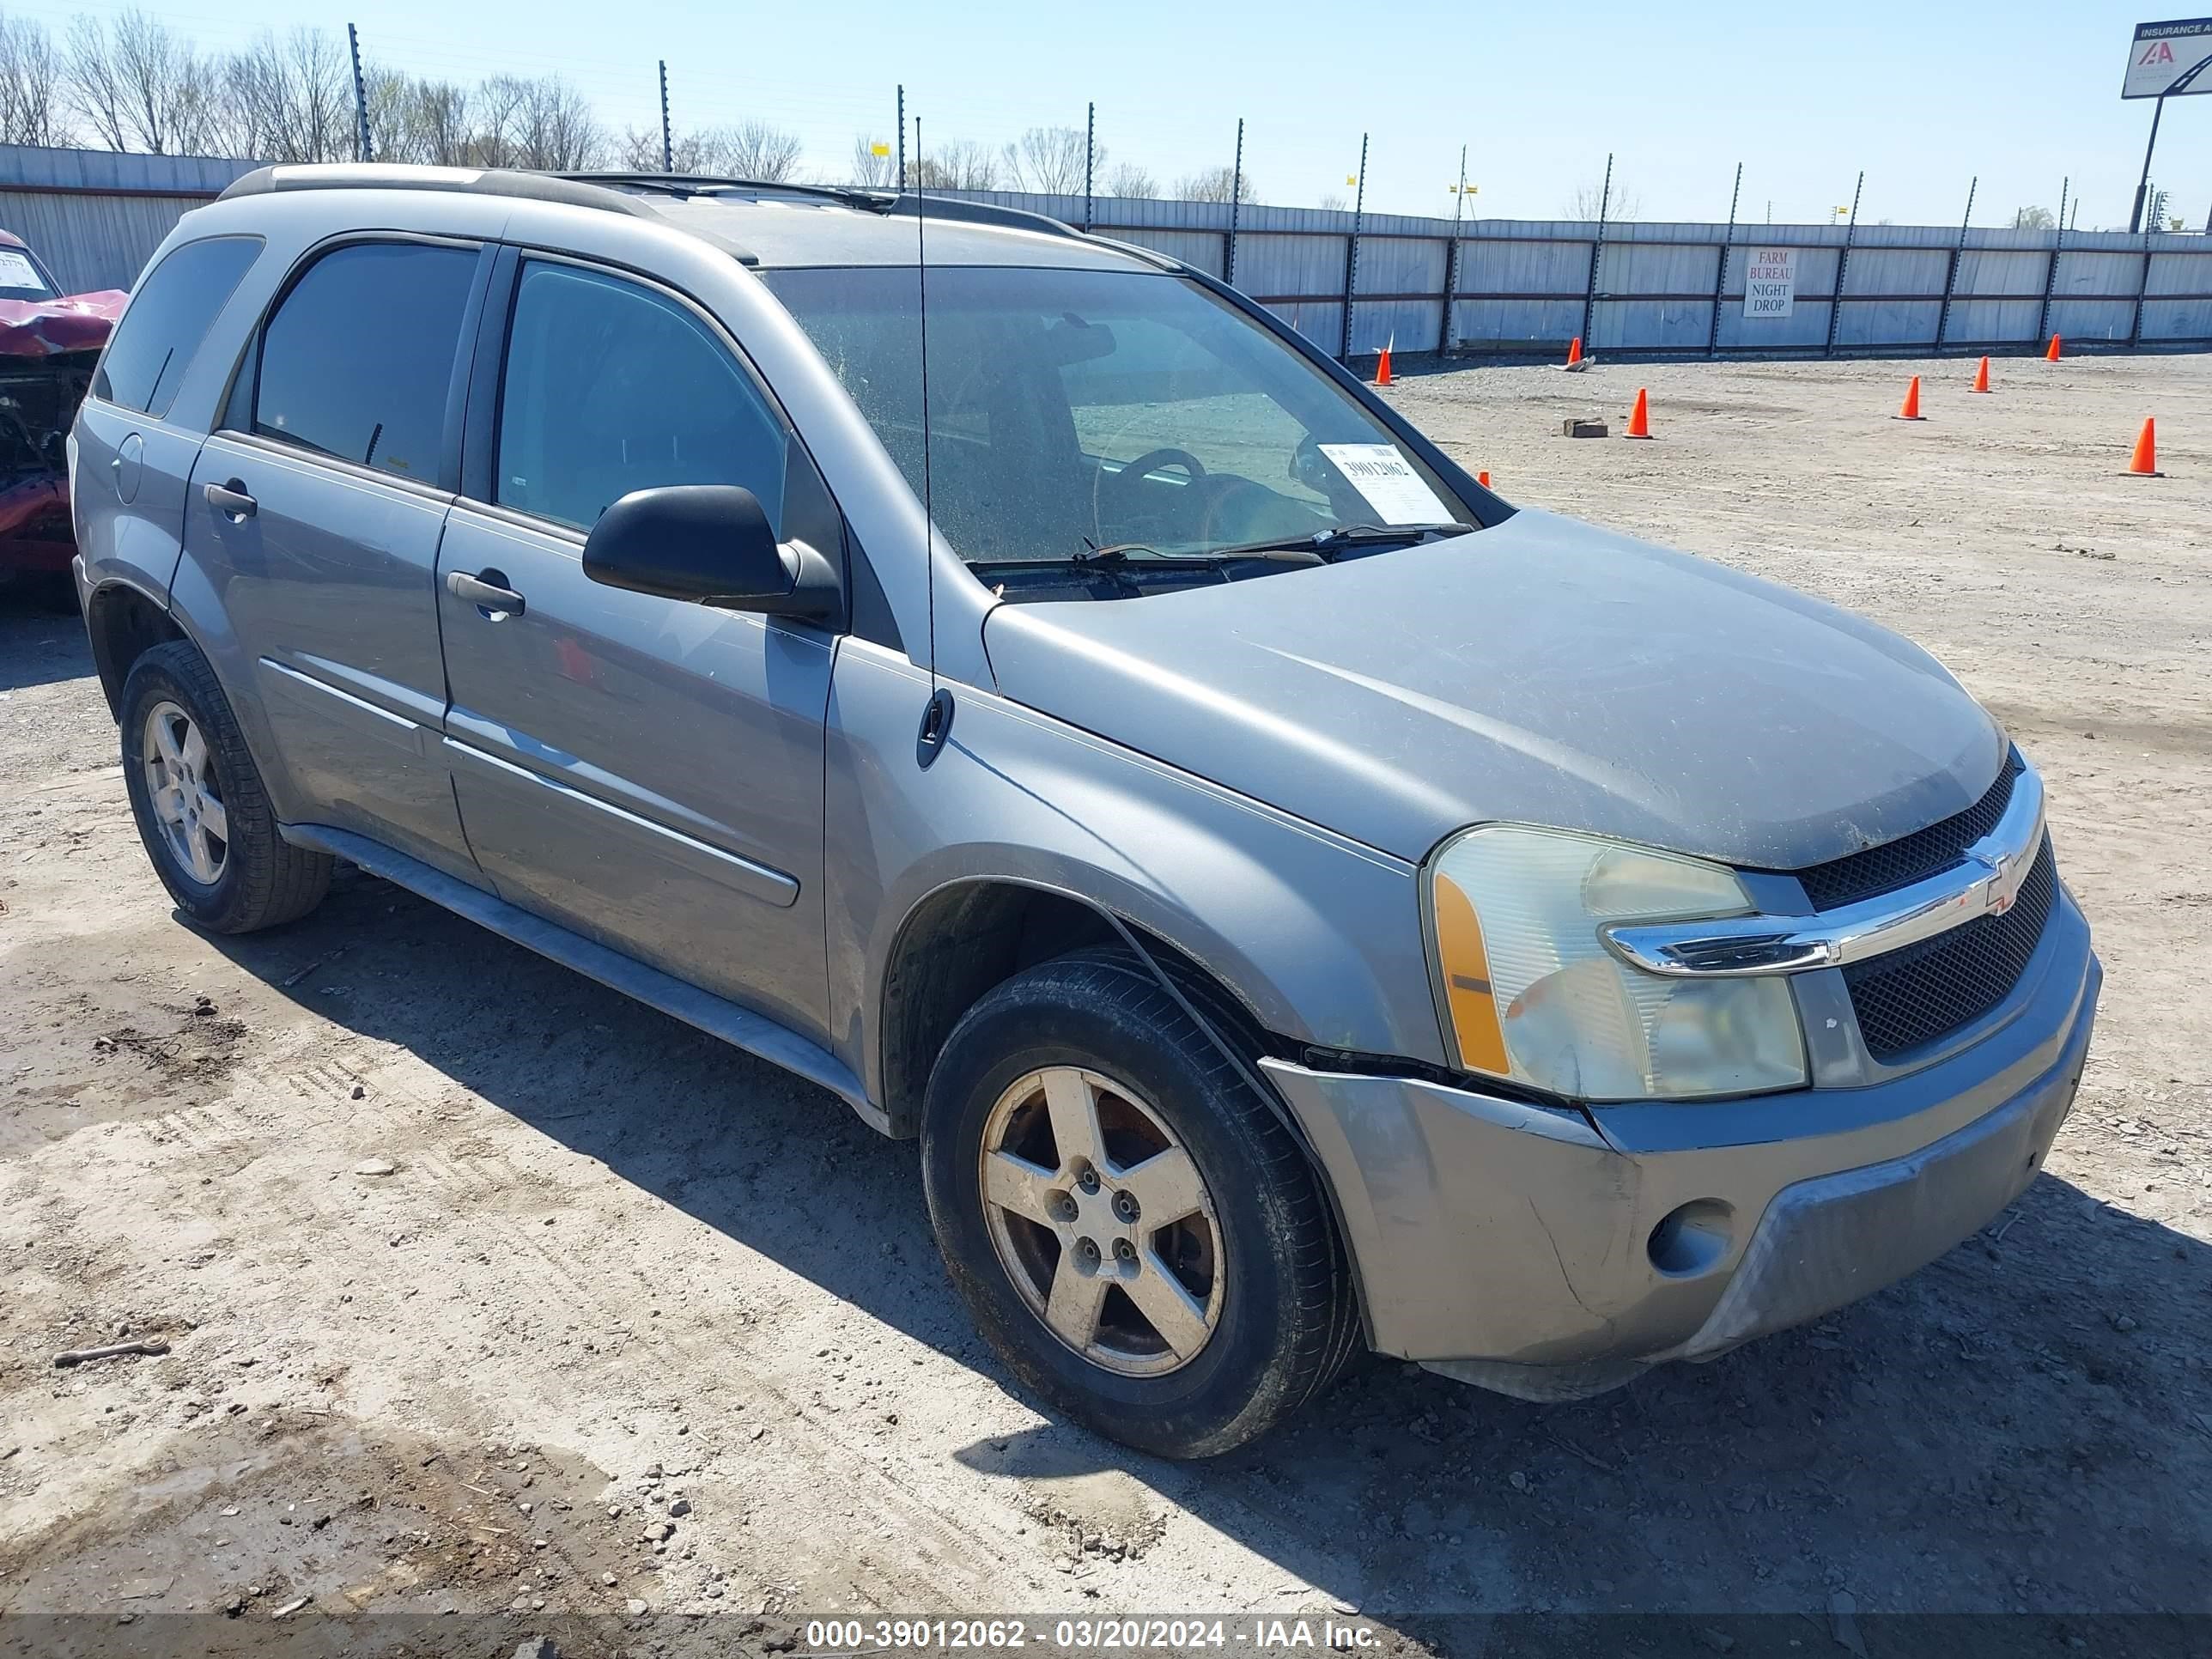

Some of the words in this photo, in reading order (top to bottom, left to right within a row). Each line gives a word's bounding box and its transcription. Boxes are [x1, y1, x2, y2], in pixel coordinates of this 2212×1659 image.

[2141, 24, 2202, 38] INSURANCE
[1759, 252, 1789, 264] FARM
[1750, 267, 1793, 280] BUREAU
[1752, 284, 1789, 296] NIGHT
[1753, 299, 1785, 312] DROP
[1343, 461, 1409, 477] 39012062
